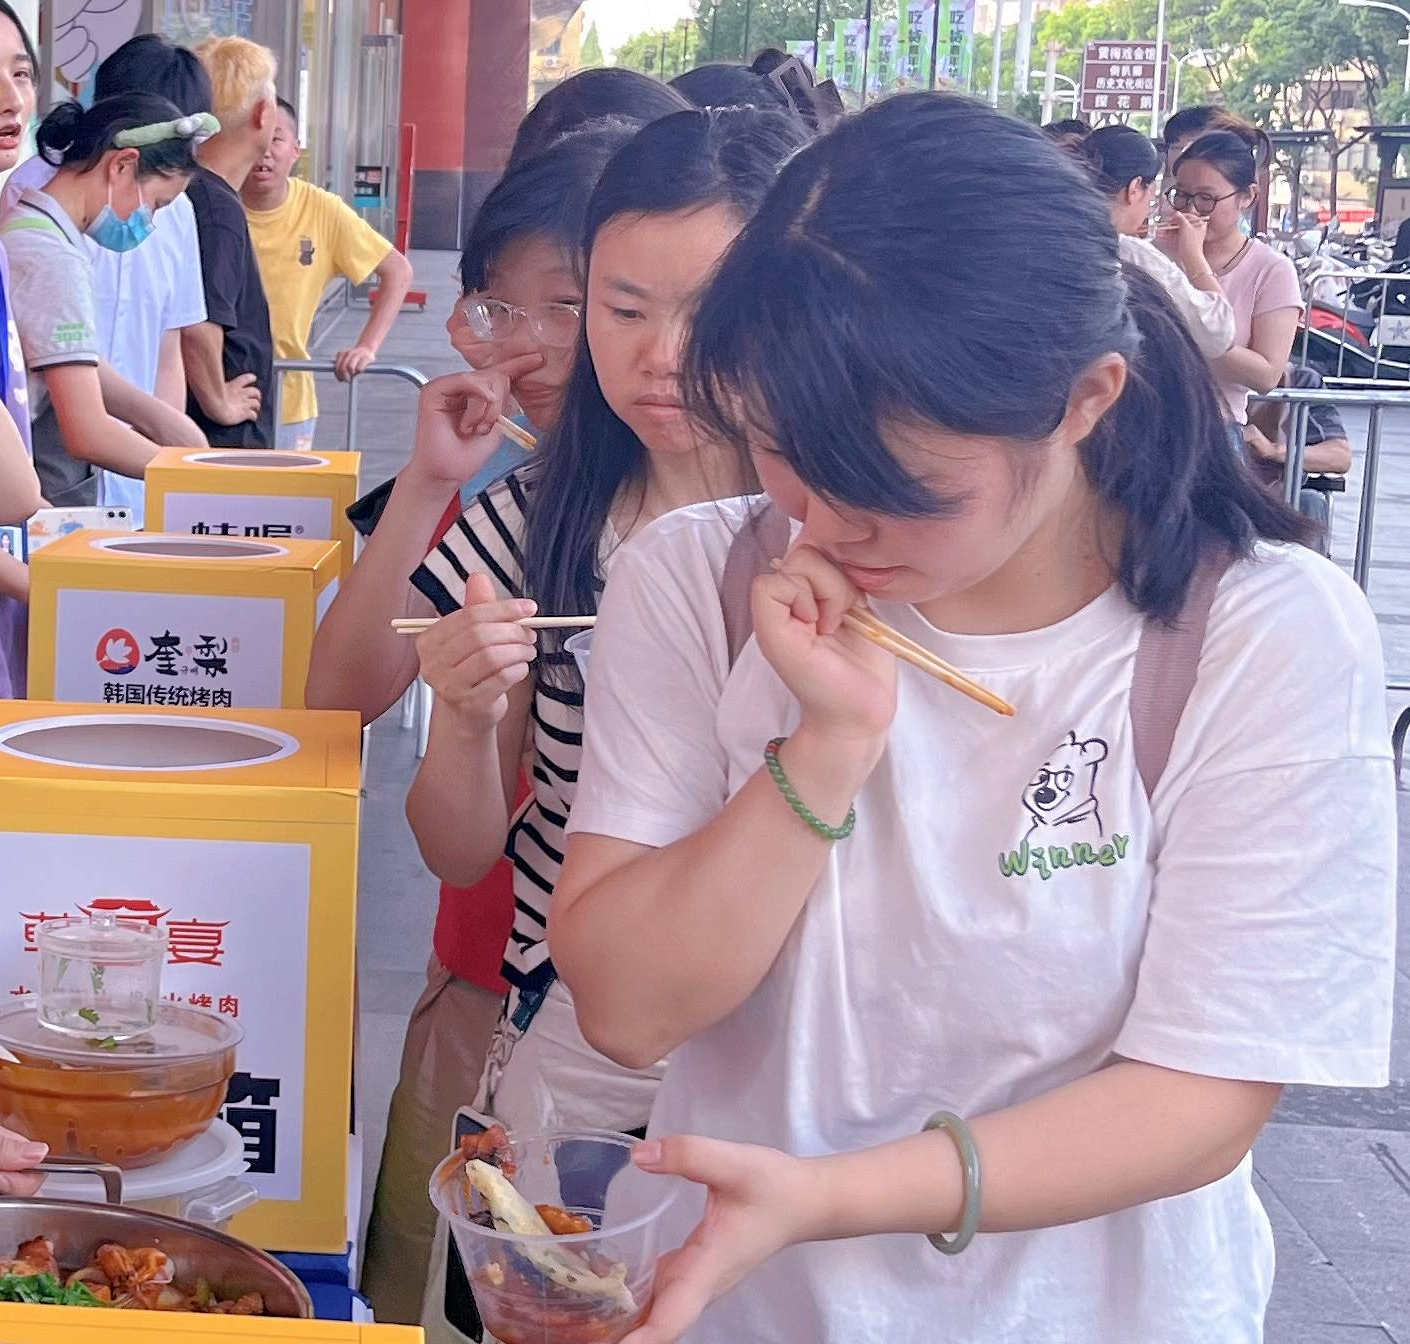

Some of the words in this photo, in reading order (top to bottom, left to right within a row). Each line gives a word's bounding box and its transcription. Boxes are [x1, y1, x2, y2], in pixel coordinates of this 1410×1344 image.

[102, 681, 233, 708] 韩国传统烤肉
